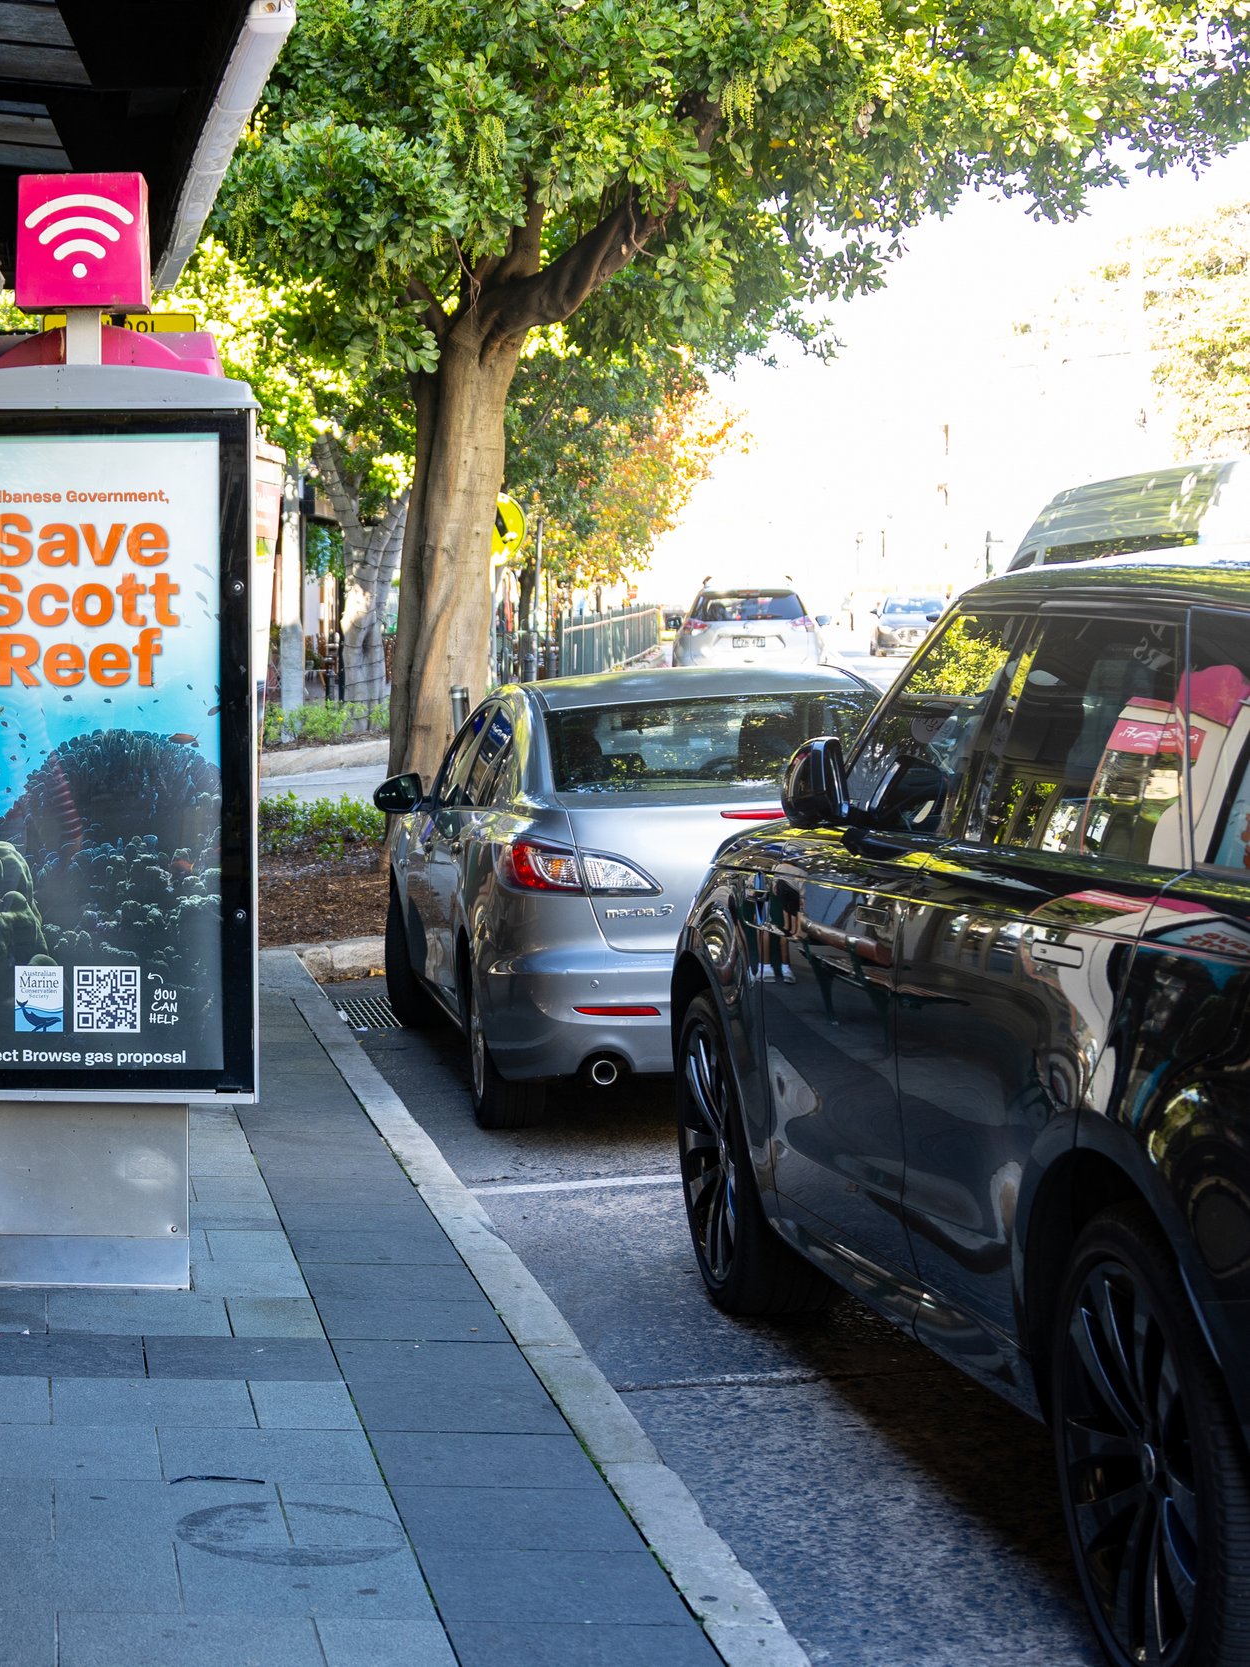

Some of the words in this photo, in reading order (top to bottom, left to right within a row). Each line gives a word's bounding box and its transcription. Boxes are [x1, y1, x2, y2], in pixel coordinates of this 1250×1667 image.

[66, 490, 169, 504] Government,
[19, 975, 59, 988] Marine
[151, 1001, 178, 1013] CAN
[148, 1012, 179, 1026] HELP
[22, 1049, 81, 1064] Browse
[84, 1052, 114, 1067] gas
[116, 1049, 187, 1067] proposal
